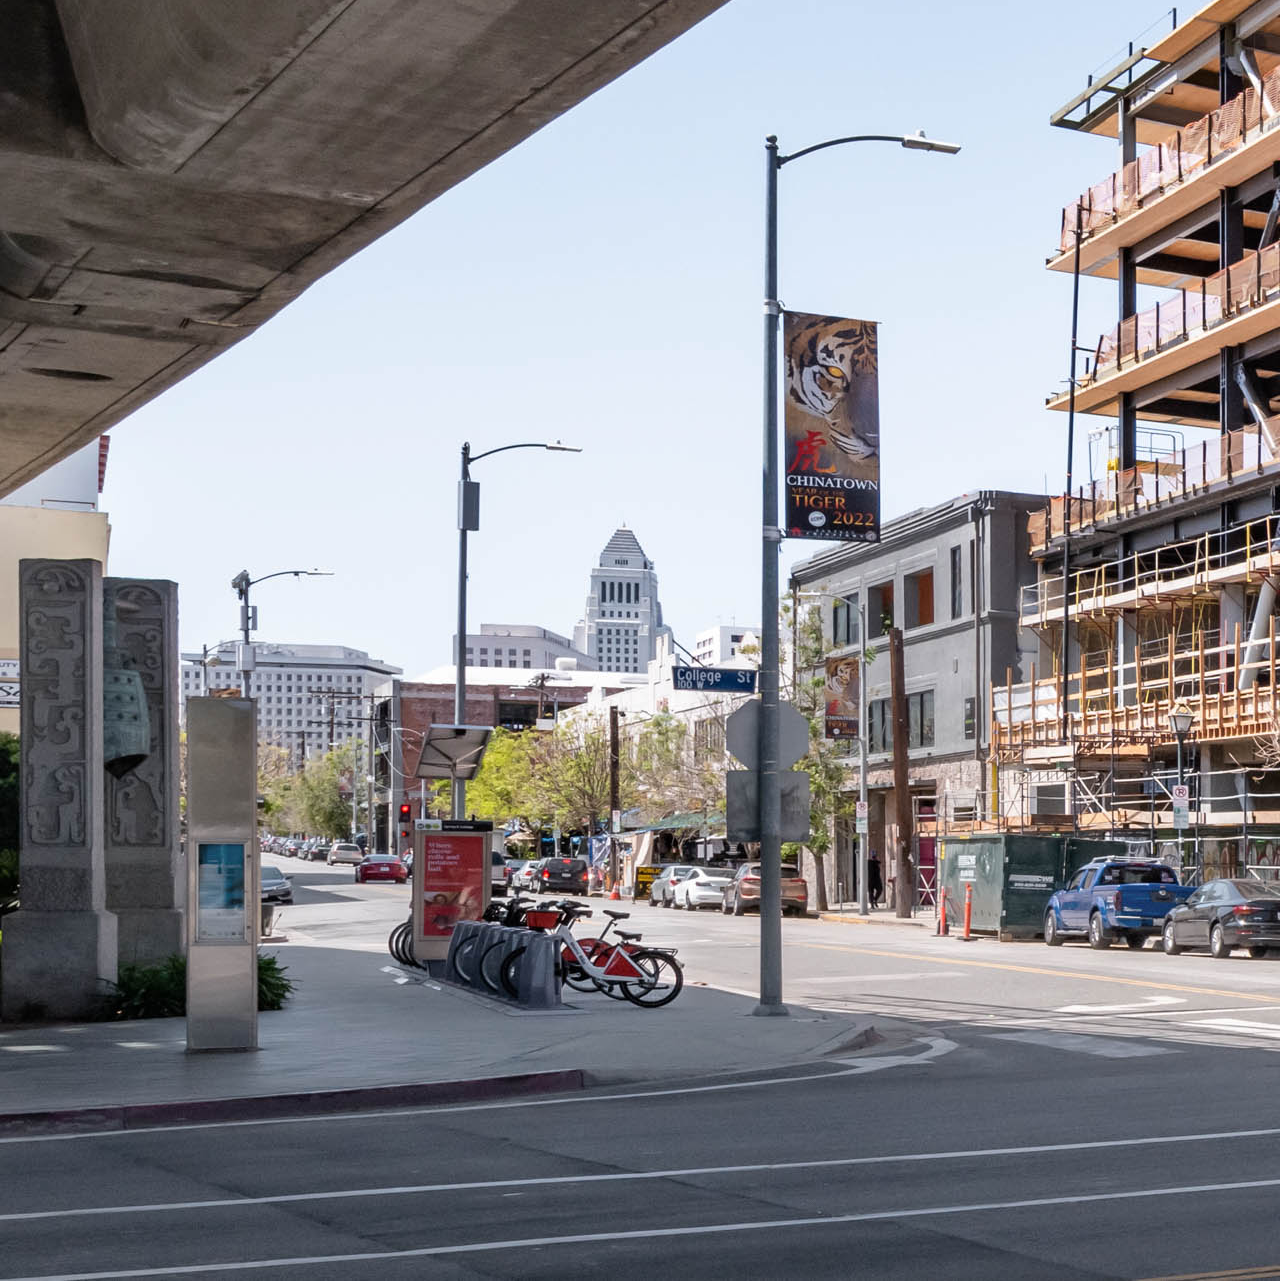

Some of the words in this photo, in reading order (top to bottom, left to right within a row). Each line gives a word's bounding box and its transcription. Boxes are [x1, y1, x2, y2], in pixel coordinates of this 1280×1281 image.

[786, 475, 878, 490] CHINATOWN
[792, 494, 846, 510] TIGER
[832, 511, 874, 526] 2022
[677, 668, 722, 686] College
[736, 670, 751, 684] St
[678, 680, 693, 689] 100
[696, 680, 704, 690] W
